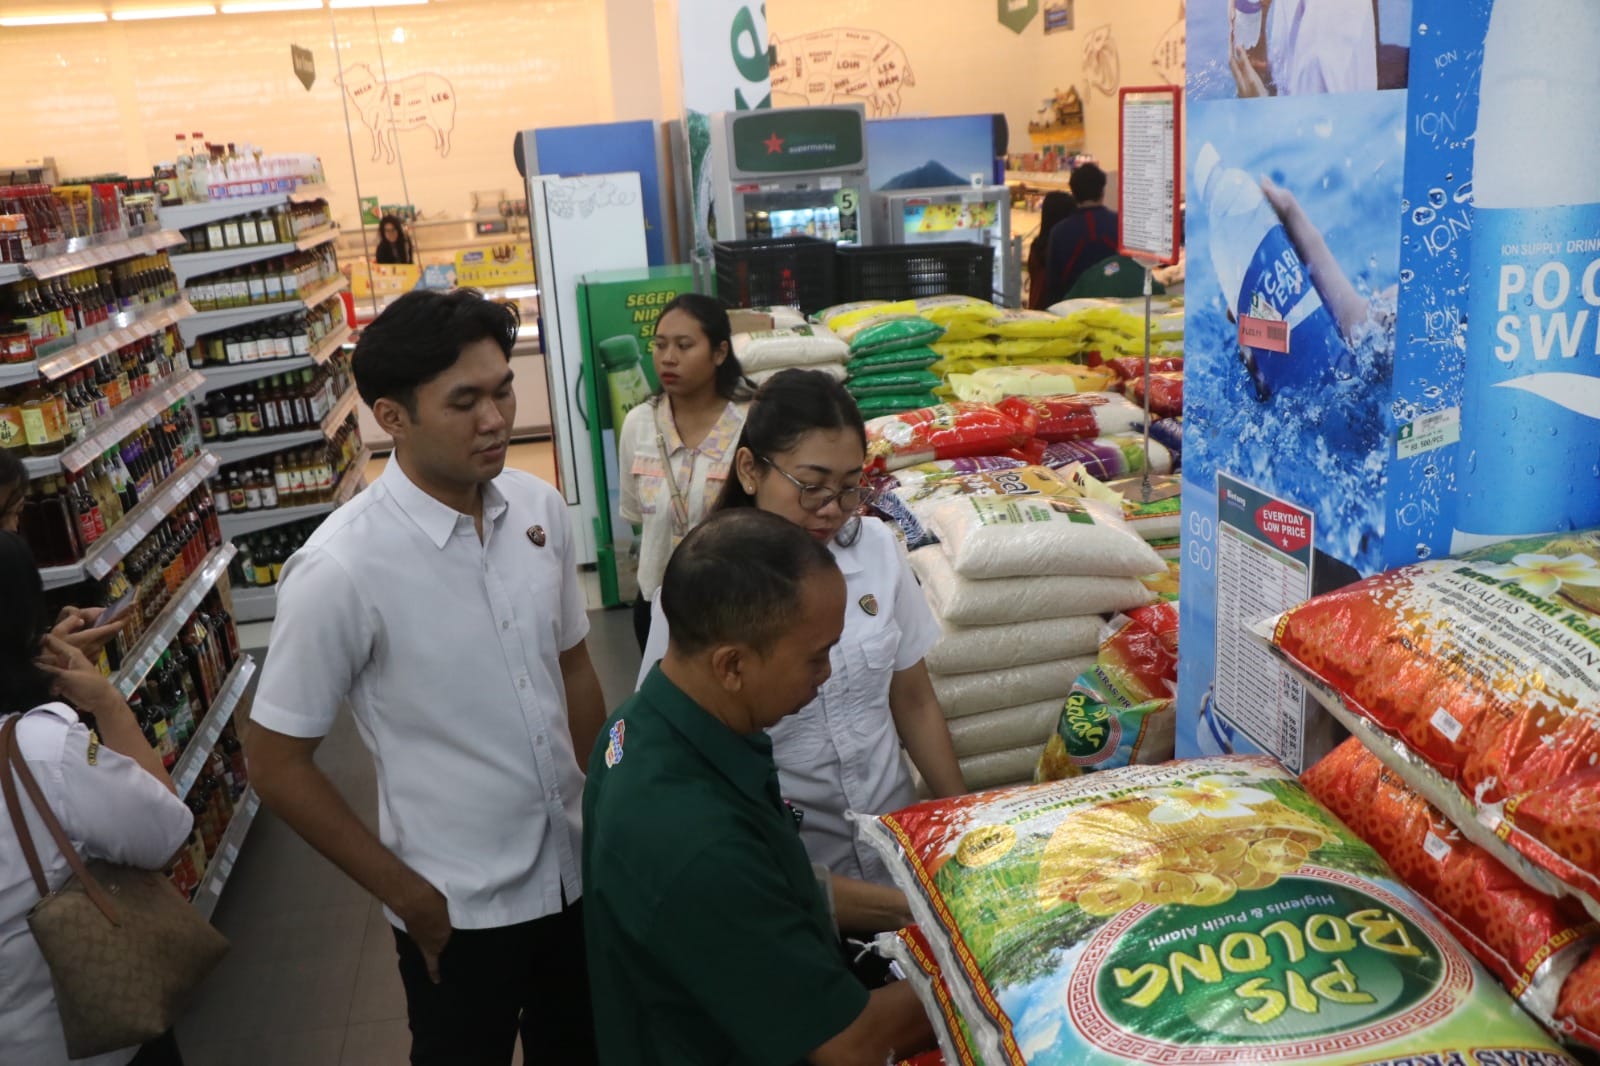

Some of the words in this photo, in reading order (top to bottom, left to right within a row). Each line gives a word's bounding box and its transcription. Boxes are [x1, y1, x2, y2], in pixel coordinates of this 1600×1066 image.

[837, 61, 860, 69] LOIN
[878, 62, 896, 74] LEG
[1434, 50, 1458, 69] ION
[878, 75, 900, 88] HAM
[432, 92, 449, 103] LEG
[1415, 110, 1457, 136] ION
[842, 193, 852, 210] 5
[1423, 209, 1472, 257] ION
[1501, 244, 1519, 256] ION
[1521, 241, 1563, 256] SUPPLY
[626, 291, 676, 307] SEGER
[1495, 310, 1600, 362] SW
[1189, 511, 1212, 542] GO
[1263, 510, 1304, 525] EVERYDAY
[1263, 521, 1281, 533] LOW
[1281, 525, 1306, 539] PRICE
[1189, 541, 1211, 571] GO
[1498, 582, 1563, 616] Favorit
[1458, 579, 1525, 615] KUALITAS
[1522, 611, 1598, 666] TERJAMIN
[1250, 905, 1263, 920] &
[1266, 892, 1335, 914] Higienis
[1201, 911, 1248, 934] Putih
[1147, 925, 1199, 952] Alami
[1113, 907, 1423, 1007] BOLONG
[1235, 959, 1378, 1024] PIS
